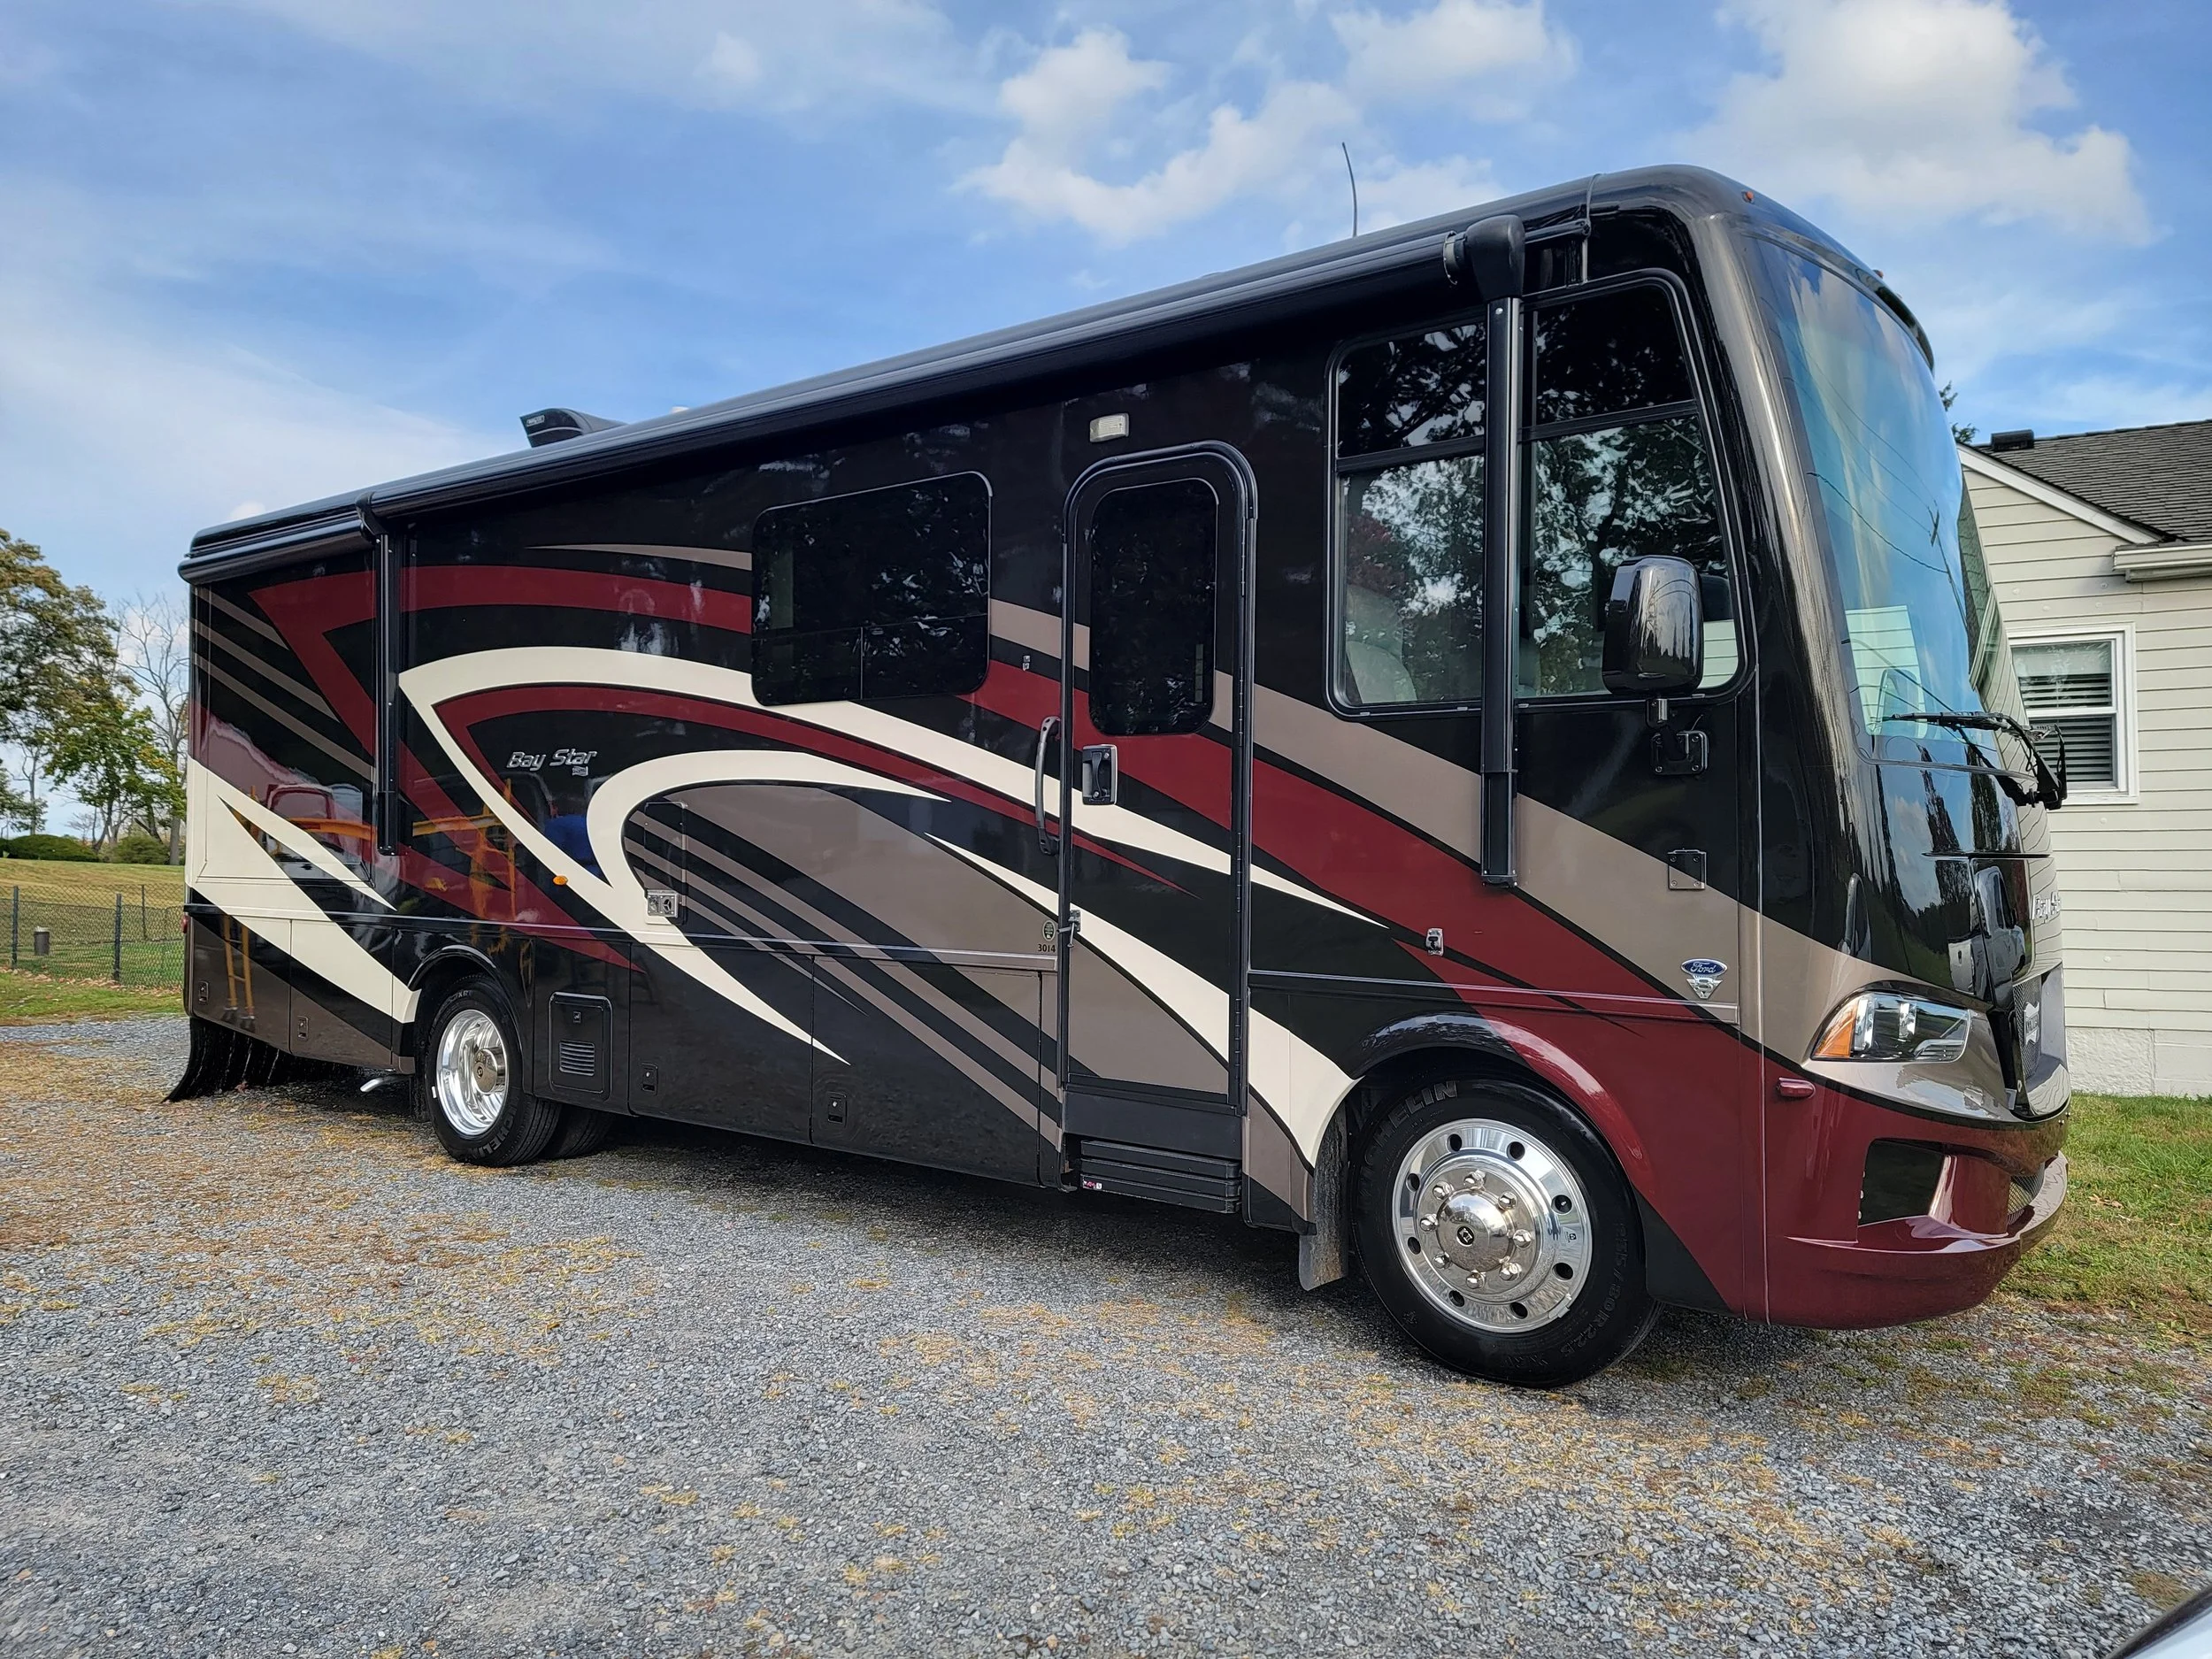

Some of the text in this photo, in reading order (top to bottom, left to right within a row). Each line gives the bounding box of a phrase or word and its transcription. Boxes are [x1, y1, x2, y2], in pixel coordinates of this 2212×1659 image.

[506, 749, 597, 772] Bay Star
[1037, 943, 1056, 953] 3014
[1690, 961, 1717, 973] Ford
